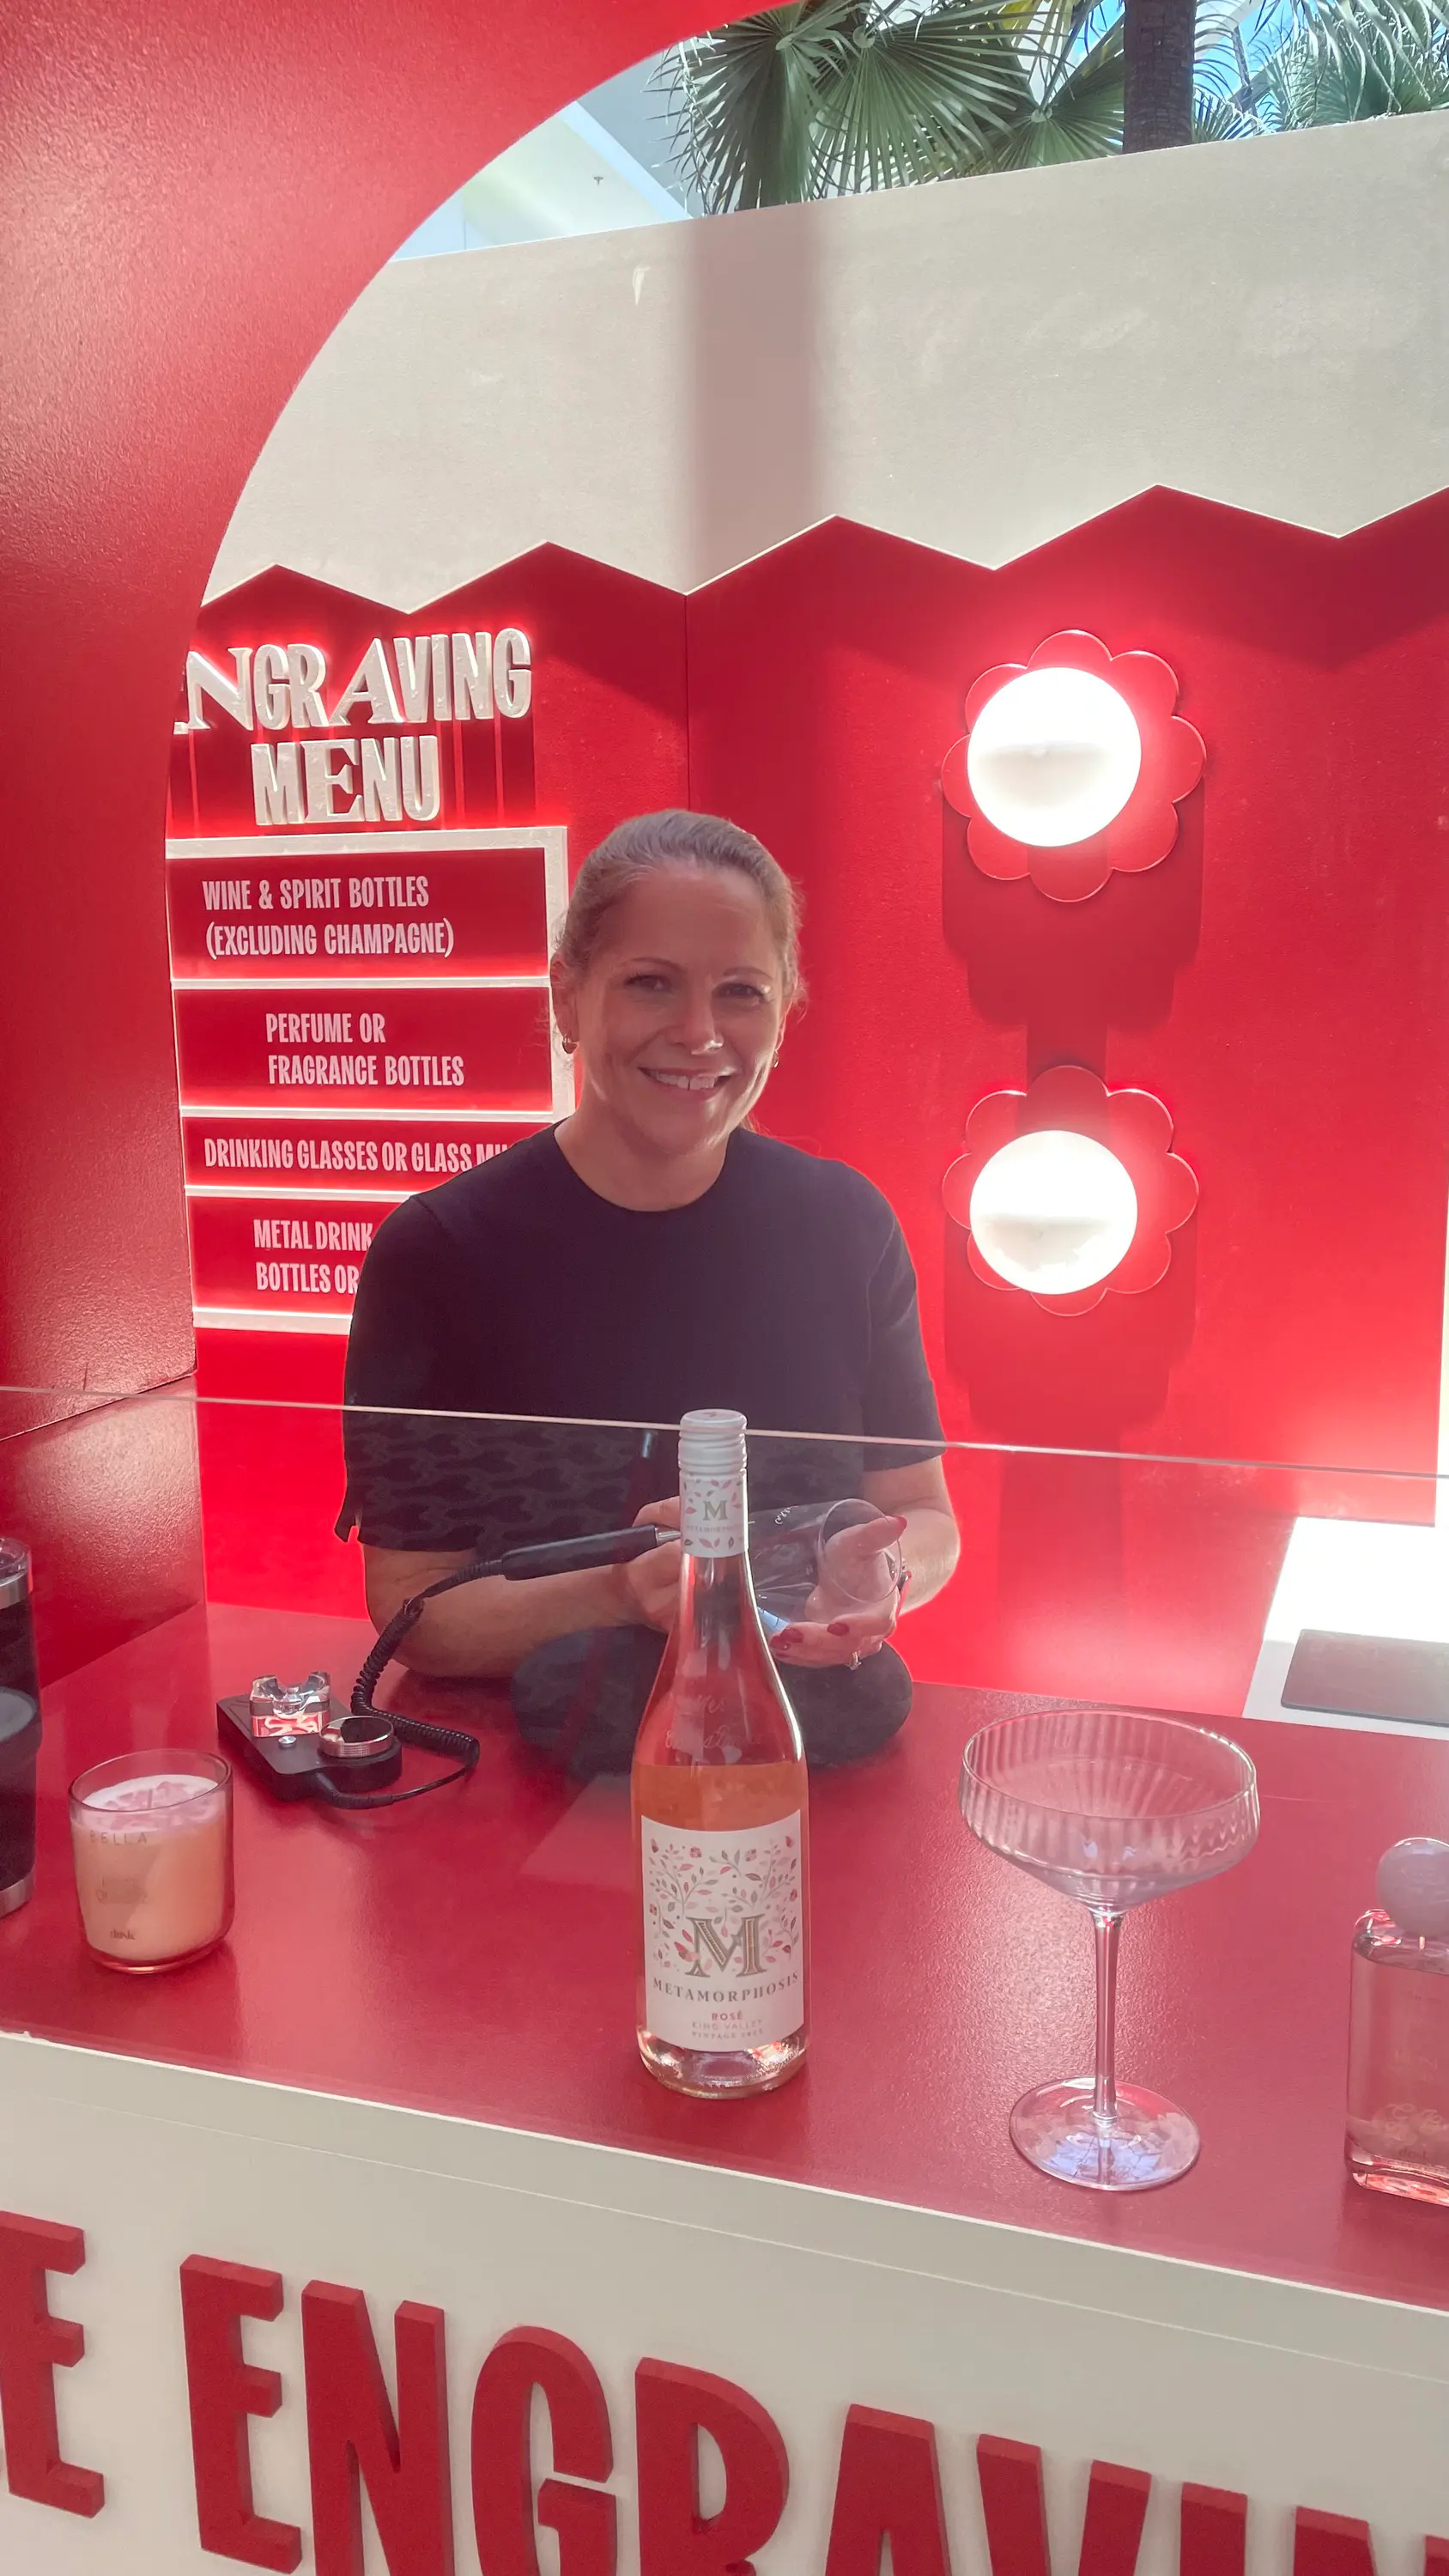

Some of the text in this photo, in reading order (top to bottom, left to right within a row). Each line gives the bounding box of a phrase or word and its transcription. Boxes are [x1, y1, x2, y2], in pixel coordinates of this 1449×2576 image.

[173, 628, 532, 735] NGRAVING
[251, 735, 442, 825] MENU
[202, 875, 429, 910] WINE & SPIRIT BOTTLES
[206, 918, 454, 960] (EXCLUDING CHAMPAGNE)
[265, 1013, 385, 1043] PERFUME OR
[268, 1055, 465, 1086] FRAGRANCE BOTTLES
[204, 1138, 294, 1170] DRINKING
[297, 1139, 378, 1171] GLASSES
[382, 1141, 408, 1172] OR
[411, 1142, 473, 1173] GLASS
[253, 1219, 313, 1249] METAL
[256, 1261, 359, 1295] BOTTLES OR
[703, 1500, 728, 1521] M
[88, 1831, 148, 1845] BELLA
[685, 1913, 767, 1978] M
[652, 1972, 798, 2002] METAMORPHOSIS
[692, 2019, 763, 2030] KING VALLEY
[712, 2009, 743, 2021] ROSÉ
